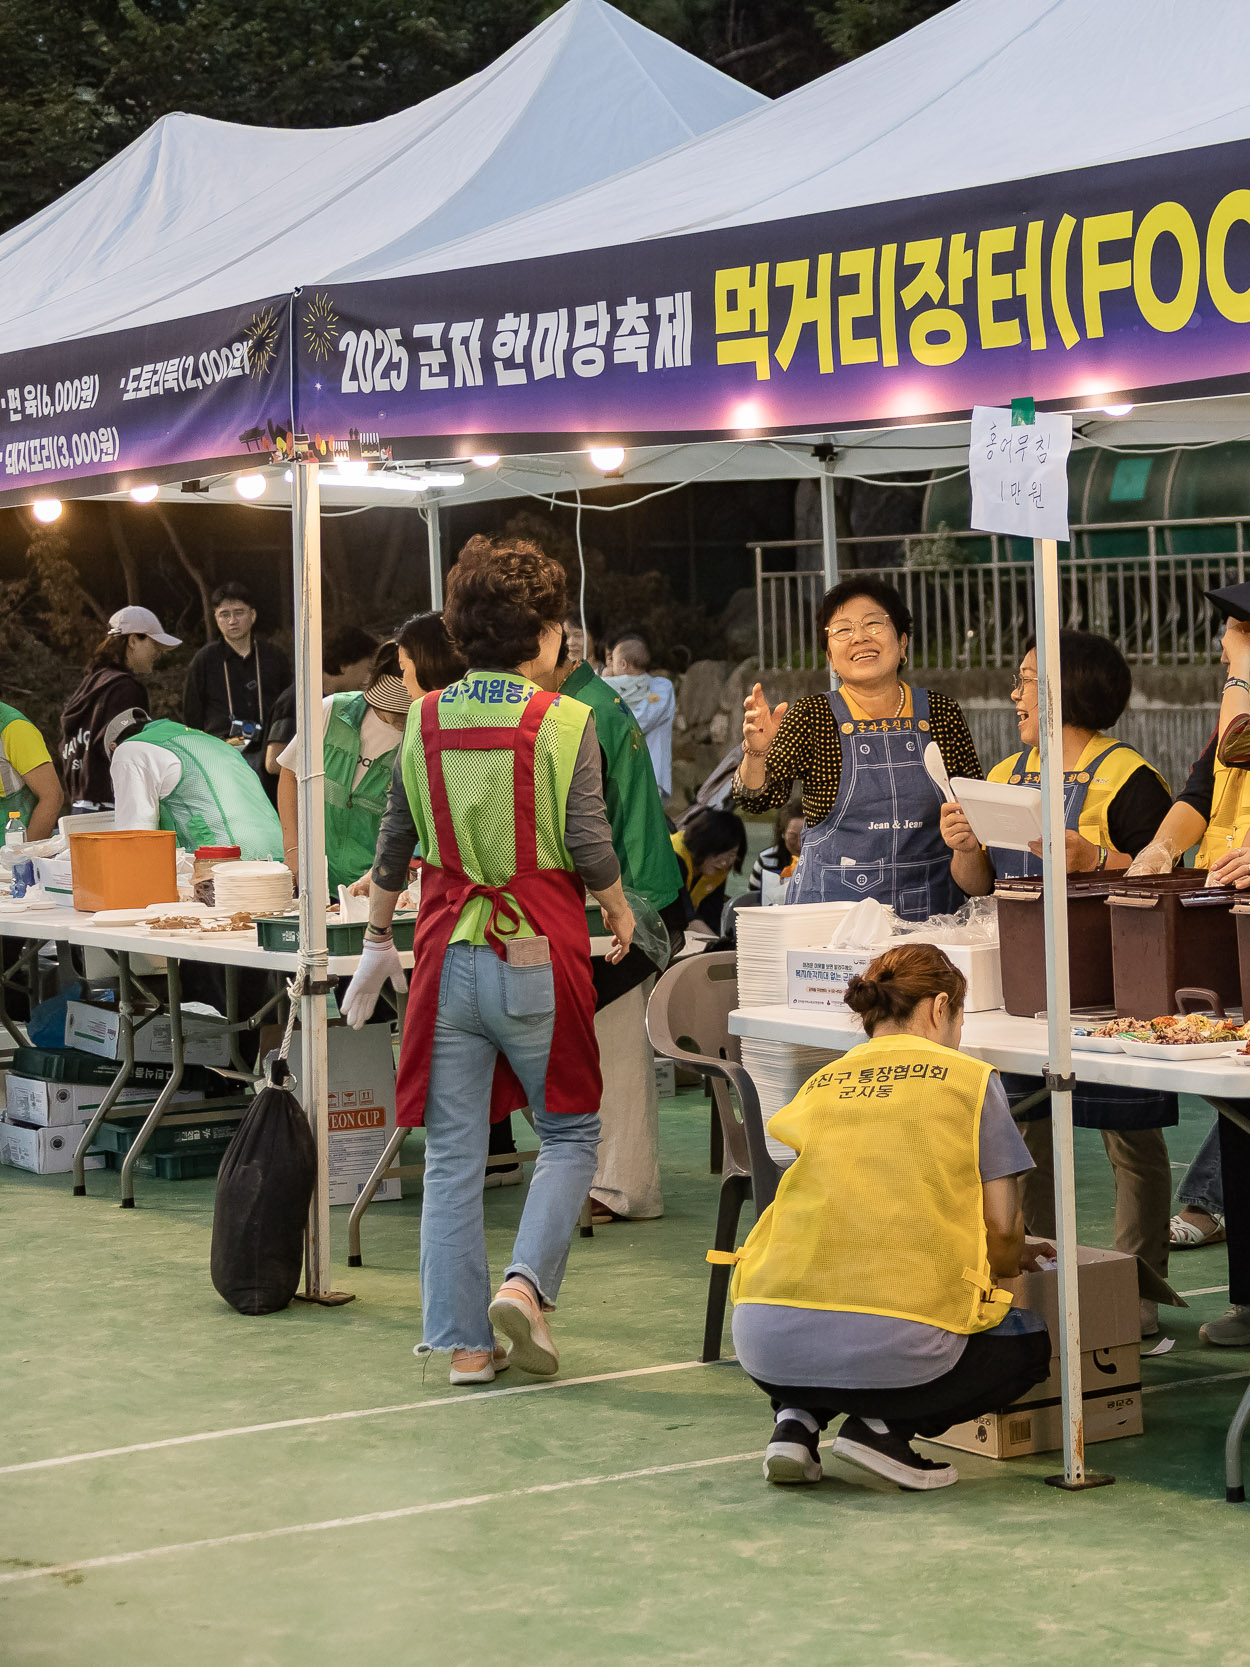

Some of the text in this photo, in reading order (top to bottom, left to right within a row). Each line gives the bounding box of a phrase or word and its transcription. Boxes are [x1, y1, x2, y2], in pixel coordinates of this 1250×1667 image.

[339, 328, 410, 394] 2025
[411, 318, 486, 391] 군자
[868, 820, 923, 830] Jean & Jean
[857, 1063, 949, 1085] 통장협의회
[838, 1084, 894, 1099] 군자동
[357, 1110, 380, 1127] CUP
